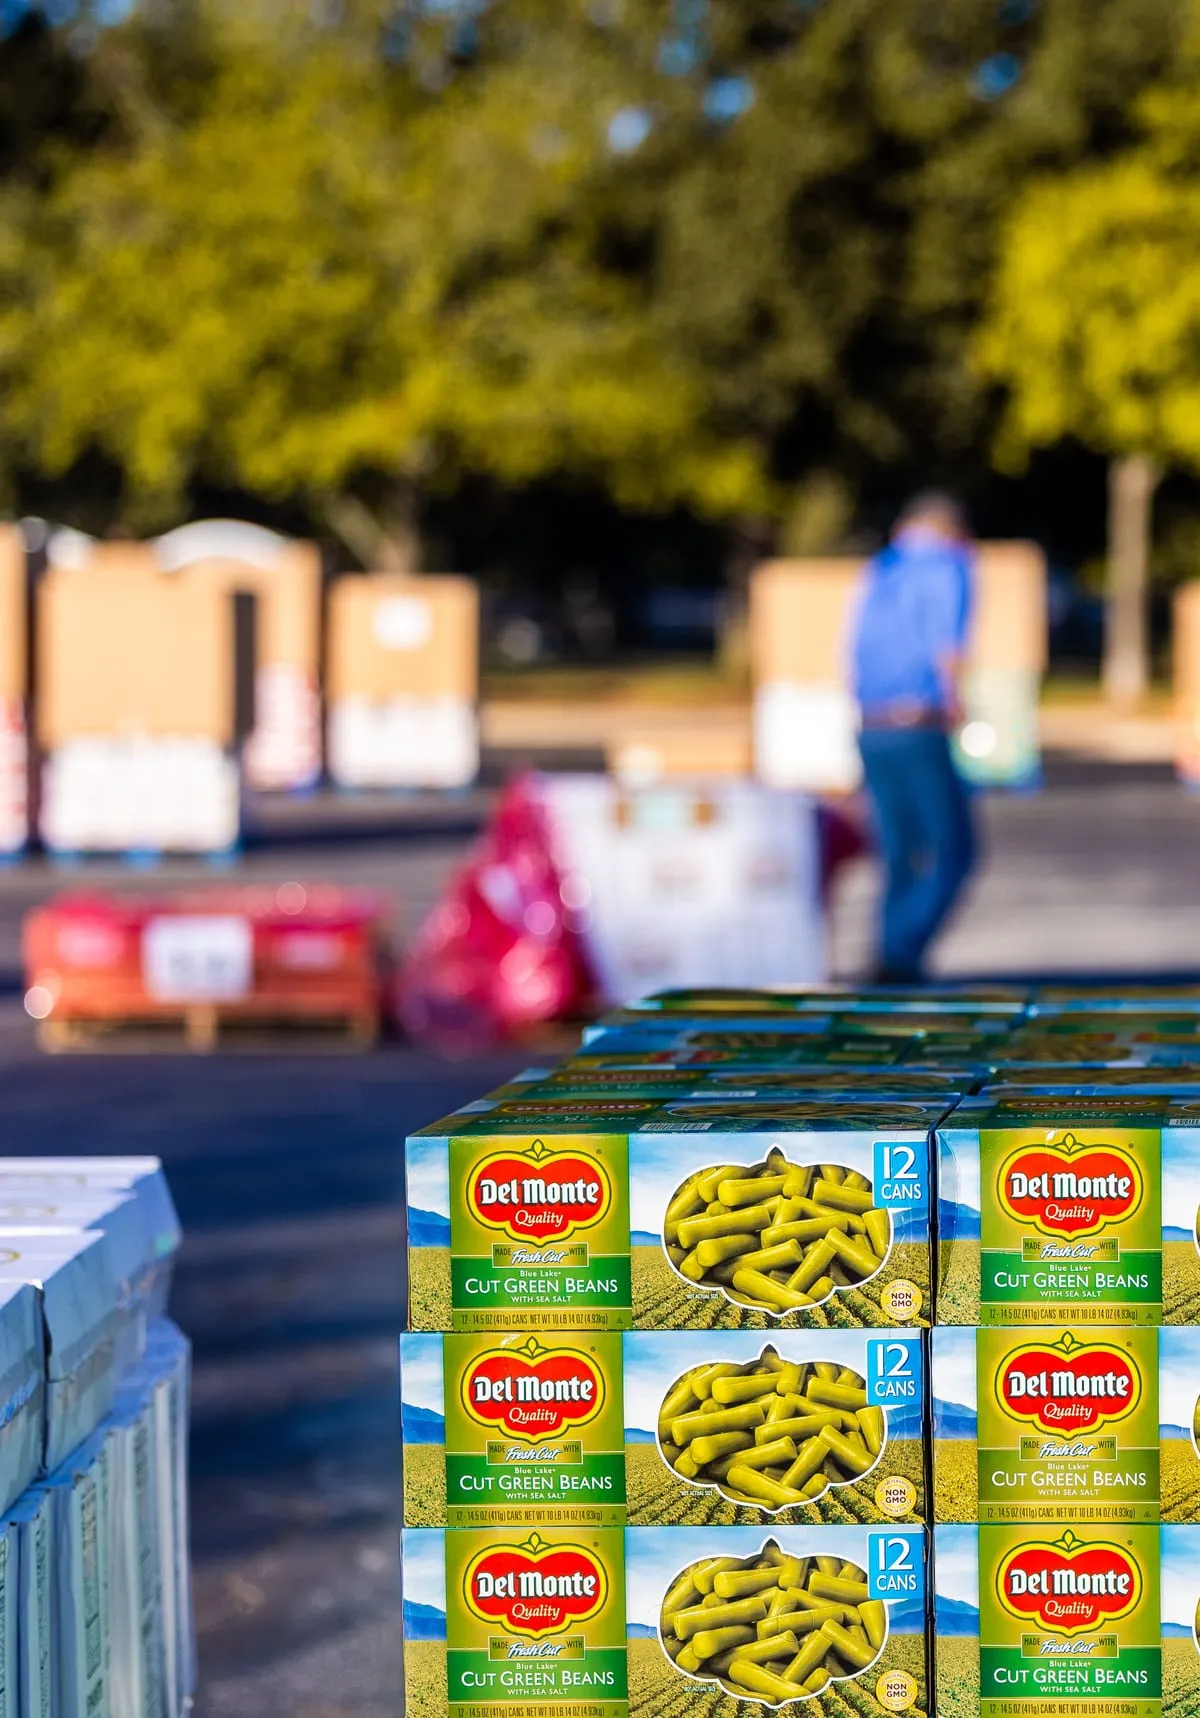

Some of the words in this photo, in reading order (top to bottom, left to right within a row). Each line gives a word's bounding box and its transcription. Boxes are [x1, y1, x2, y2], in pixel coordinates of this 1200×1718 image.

[883, 1145, 918, 1180] 12
[480, 1179, 520, 1205] Del
[522, 1178, 600, 1205] Monte
[881, 1183, 921, 1200] CANS
[1011, 1172, 1051, 1199] Del
[1053, 1172, 1132, 1199] Monte
[515, 1210, 564, 1229] Quality
[1046, 1204, 1095, 1223] Quality
[1040, 1243, 1072, 1259] Fresh
[1072, 1244, 1100, 1259] Cut
[465, 1278, 500, 1294] CUT
[503, 1277, 559, 1294] GREEN
[565, 1277, 618, 1294] BEANS
[993, 1272, 1029, 1288] CUT
[1033, 1272, 1088, 1288] GREEN
[1095, 1272, 1149, 1288] BEANS
[536, 1295, 550, 1303] SEA
[877, 1343, 912, 1377] 12
[474, 1376, 514, 1403] Del
[516, 1375, 594, 1402] Monte
[875, 1380, 915, 1397] CANS
[1009, 1371, 1049, 1398] Del
[1051, 1370, 1130, 1397] Monte
[509, 1407, 558, 1426] Quality
[1044, 1402, 1093, 1421] Quality
[1023, 1440, 1039, 1449] MADE
[1098, 1440, 1114, 1449] WITH
[1038, 1441, 1070, 1458] Fresh
[1069, 1442, 1098, 1457] Cut
[458, 1474, 494, 1491] CUT
[497, 1474, 553, 1491] GREEN
[559, 1474, 613, 1490] BEANS
[991, 1470, 1027, 1487] CUT
[1030, 1470, 1086, 1487] GREEN
[1093, 1470, 1147, 1487] BEANS
[1063, 1488, 1077, 1496] SEA
[1080, 1488, 1099, 1496] SALT
[878, 1537, 913, 1571] 12
[477, 1572, 517, 1598] Del
[519, 1570, 597, 1598] Monte
[876, 1574, 916, 1591] CANS
[1009, 1569, 1050, 1595] Del
[1052, 1569, 1131, 1595] Monte
[512, 1602, 561, 1622] Quality
[1045, 1600, 1094, 1619] Quality
[507, 1642, 539, 1658] Fresh
[538, 1642, 566, 1657] Cut
[461, 1670, 497, 1687] CUT
[500, 1670, 555, 1687] GREEN
[561, 1670, 615, 1686] BEANS
[993, 1667, 1029, 1684] CUT
[1032, 1668, 1088, 1684] GREEN
[1094, 1668, 1148, 1684] BEANS
[507, 1688, 530, 1696] WITH
[886, 1690, 908, 1698] GMO
